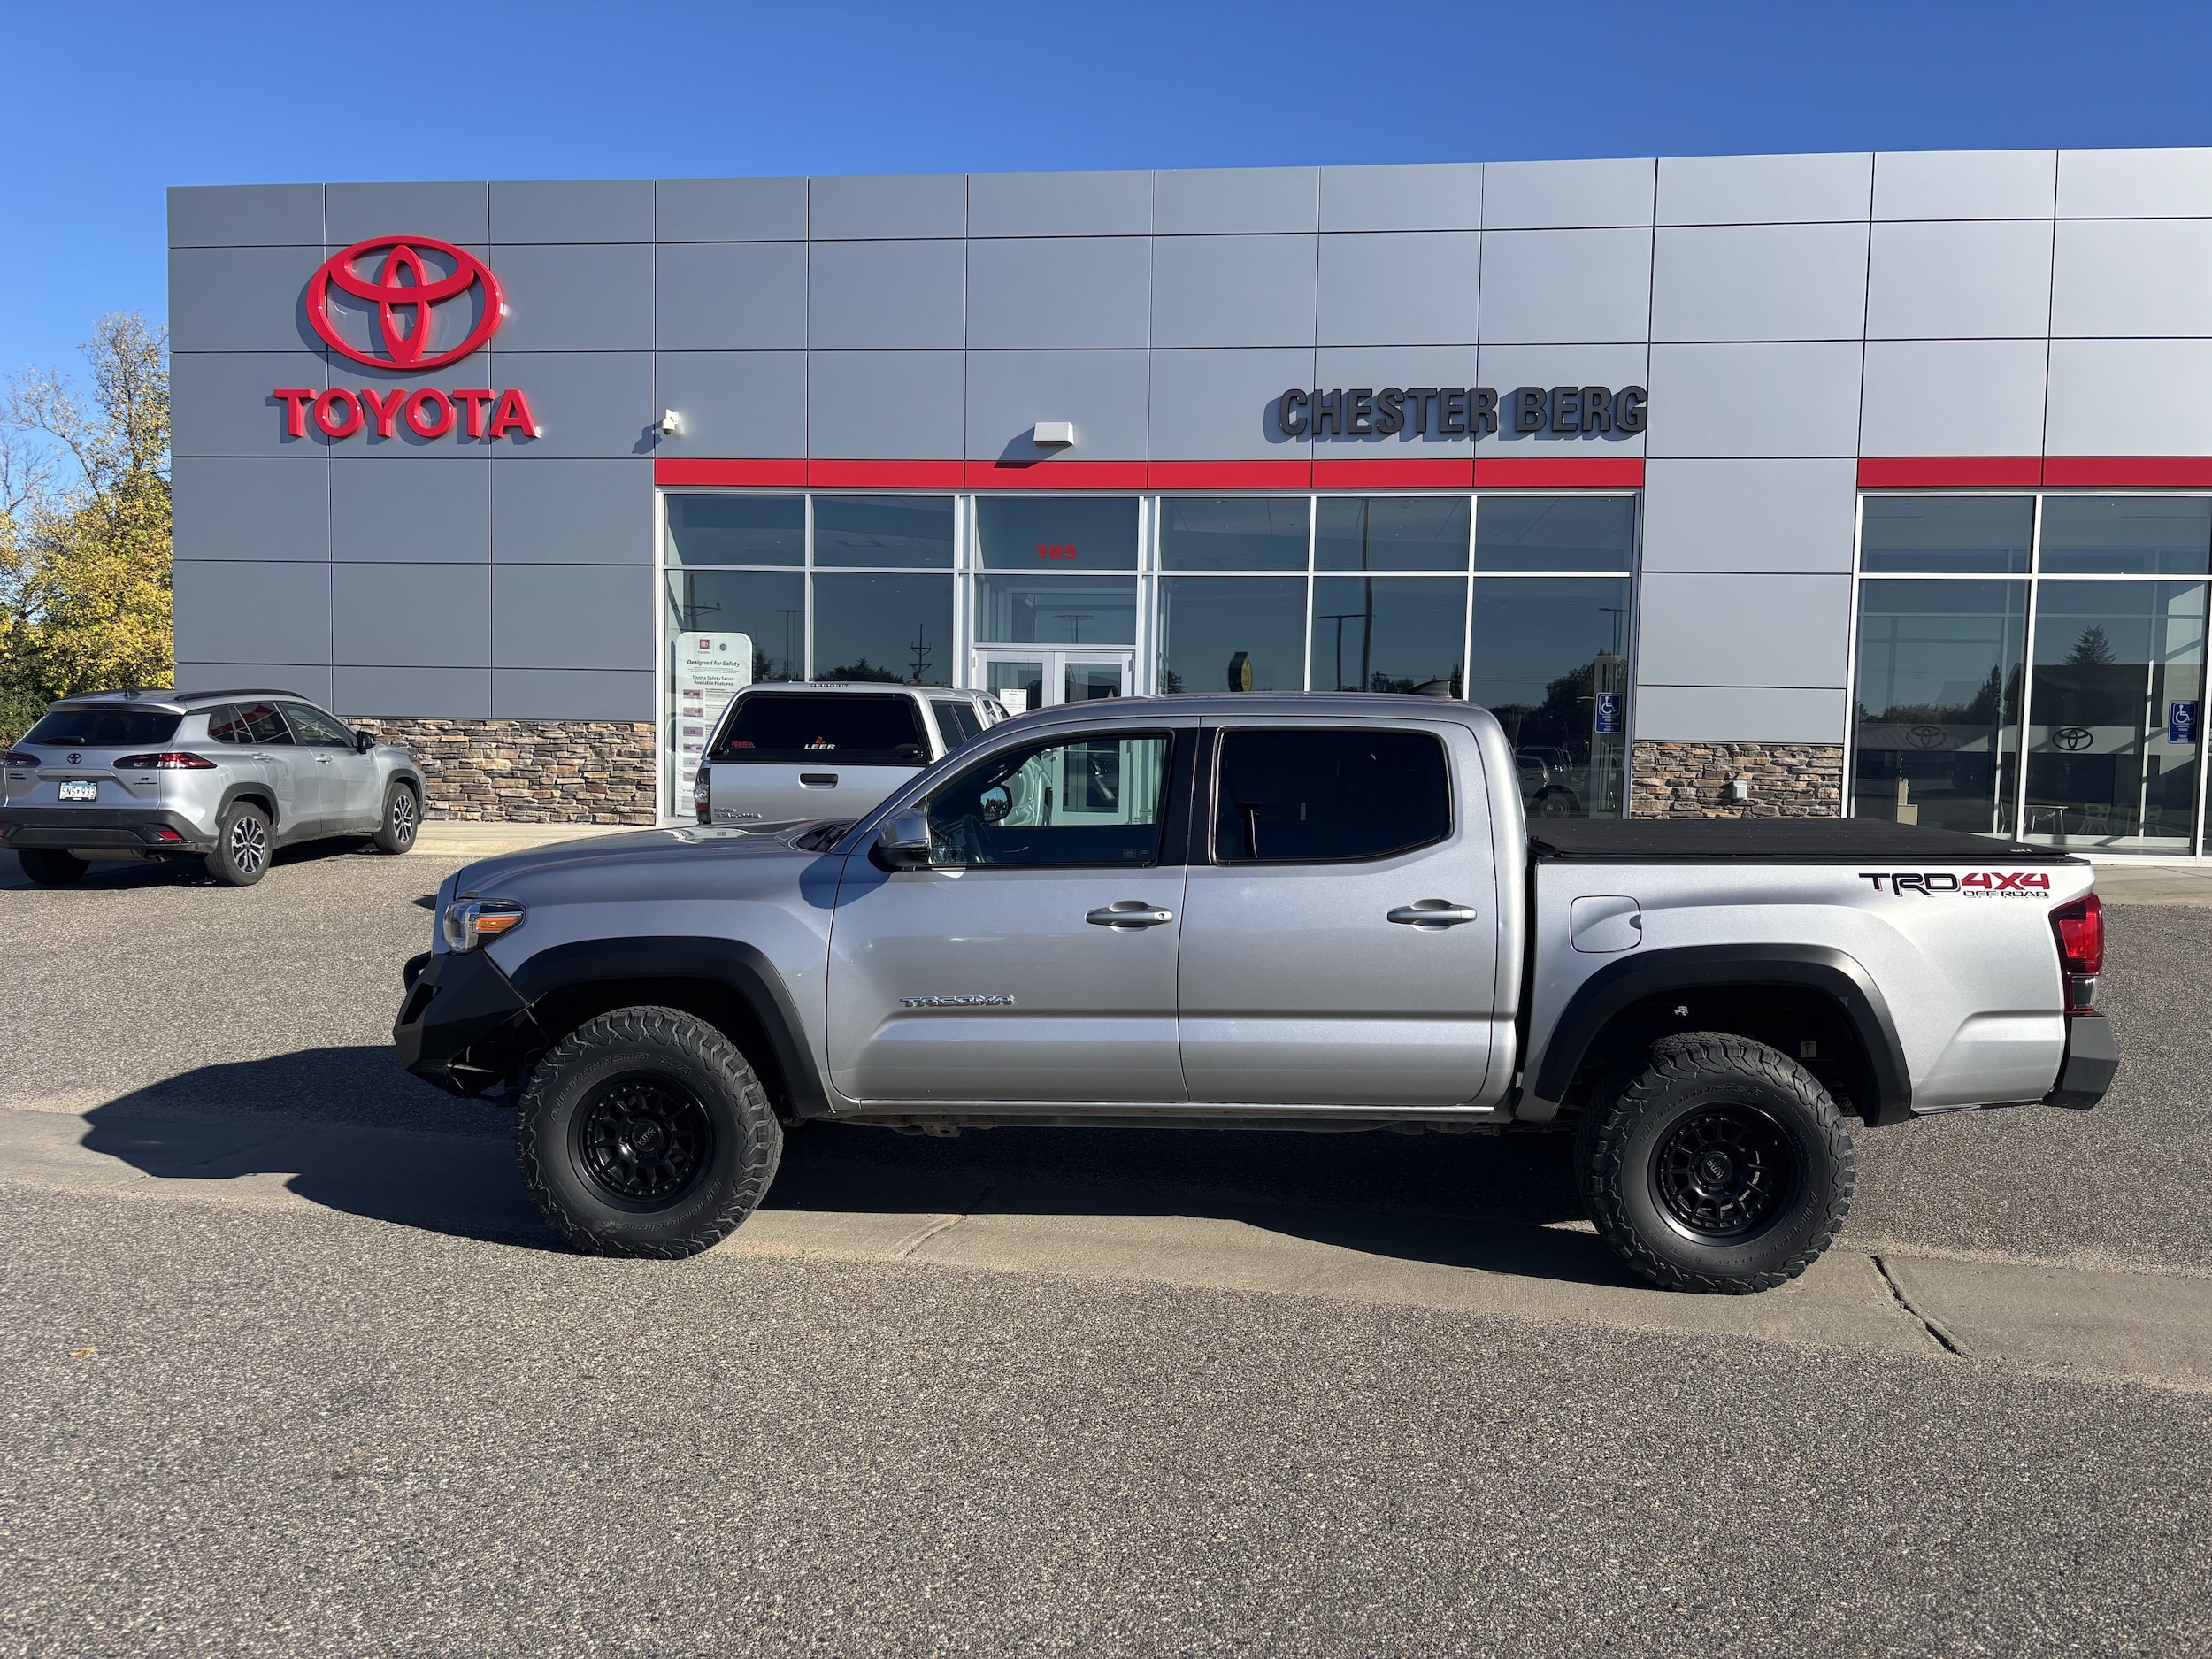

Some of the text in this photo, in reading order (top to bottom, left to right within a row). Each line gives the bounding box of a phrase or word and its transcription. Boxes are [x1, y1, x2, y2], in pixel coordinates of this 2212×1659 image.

[273, 388, 541, 438] TOYOTA
[1279, 385, 1648, 434] CHESTER BERG
[1035, 544, 1077, 560] 705
[1858, 872, 1962, 897] TRD
[2001, 890, 2049, 899] ROAD
[899, 994, 1015, 1008] TACOMA
